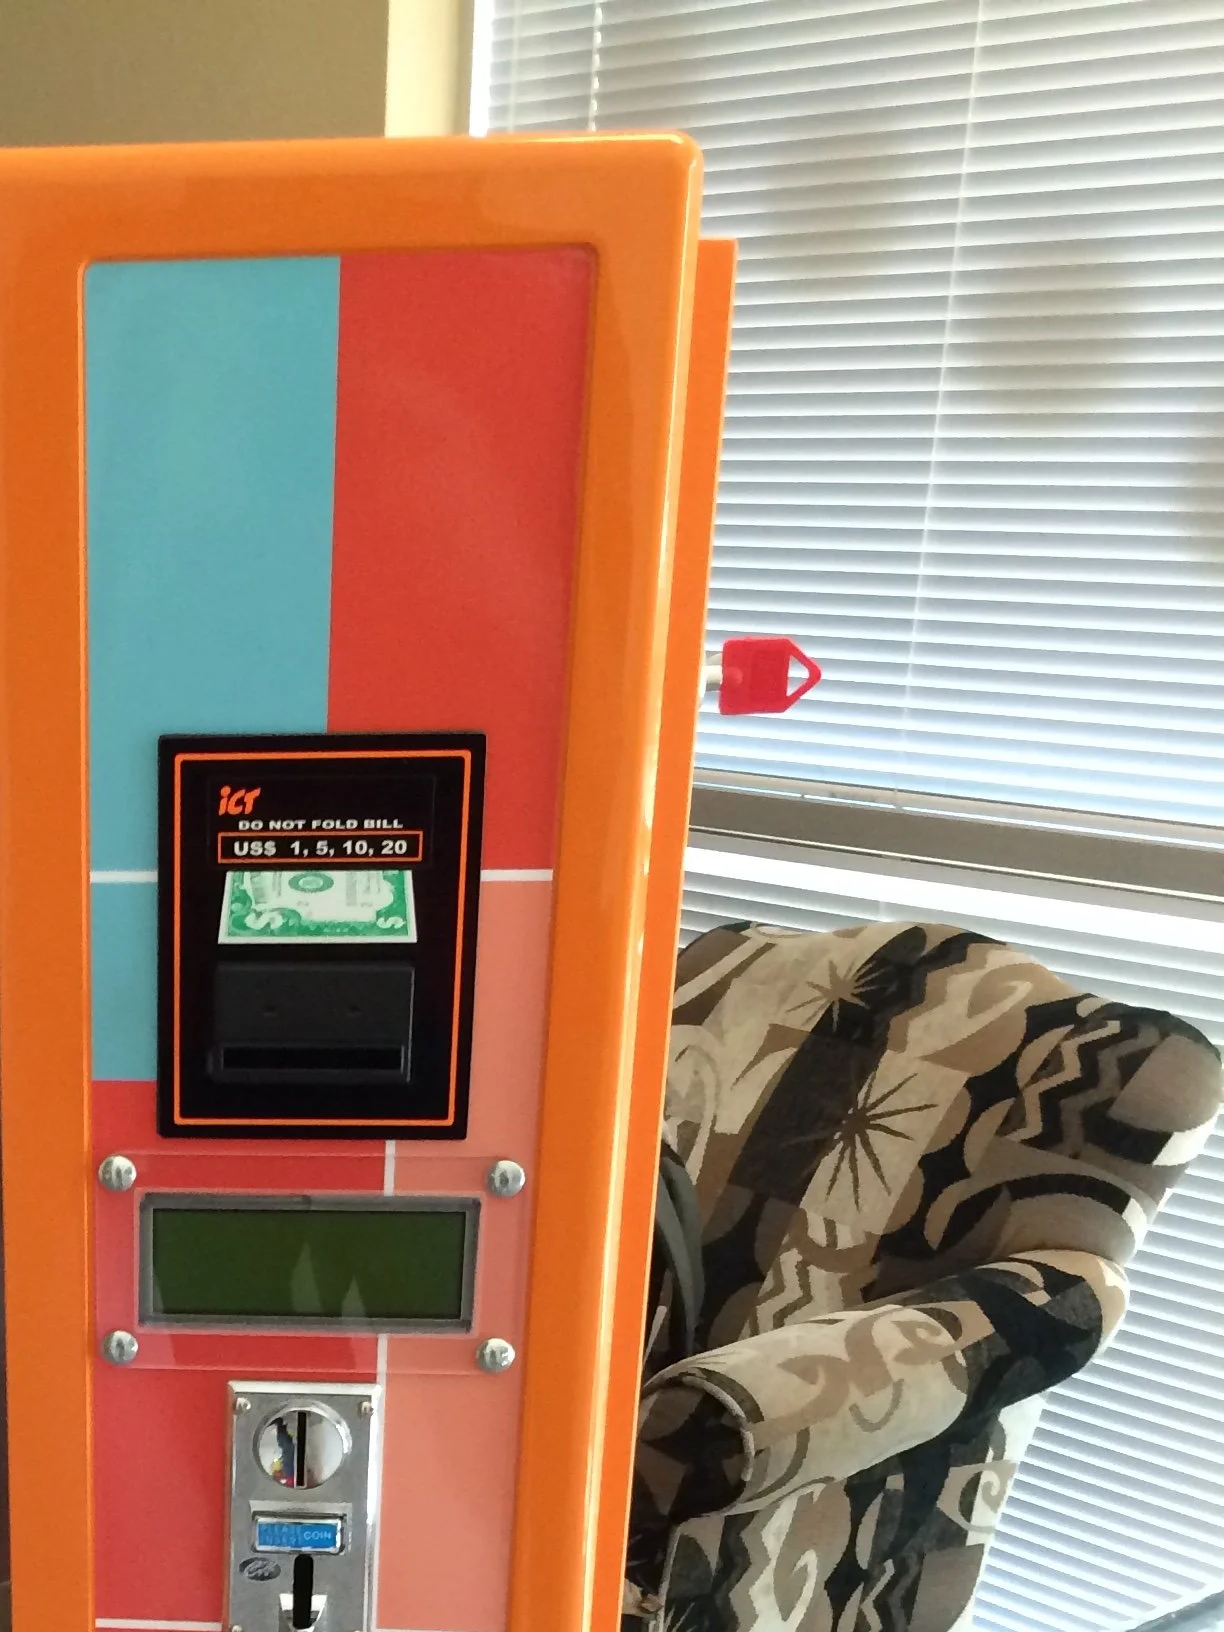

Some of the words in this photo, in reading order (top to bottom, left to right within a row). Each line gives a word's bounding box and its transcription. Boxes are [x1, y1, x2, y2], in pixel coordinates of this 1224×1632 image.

[238, 820, 264, 831] DO
[269, 820, 307, 831] NOT
[311, 819, 359, 830] FOLD
[363, 818, 404, 830] BILL
[342, 840, 375, 858] 10,
[381, 840, 408, 856] 20
[303, 1530, 332, 1541] COIN
